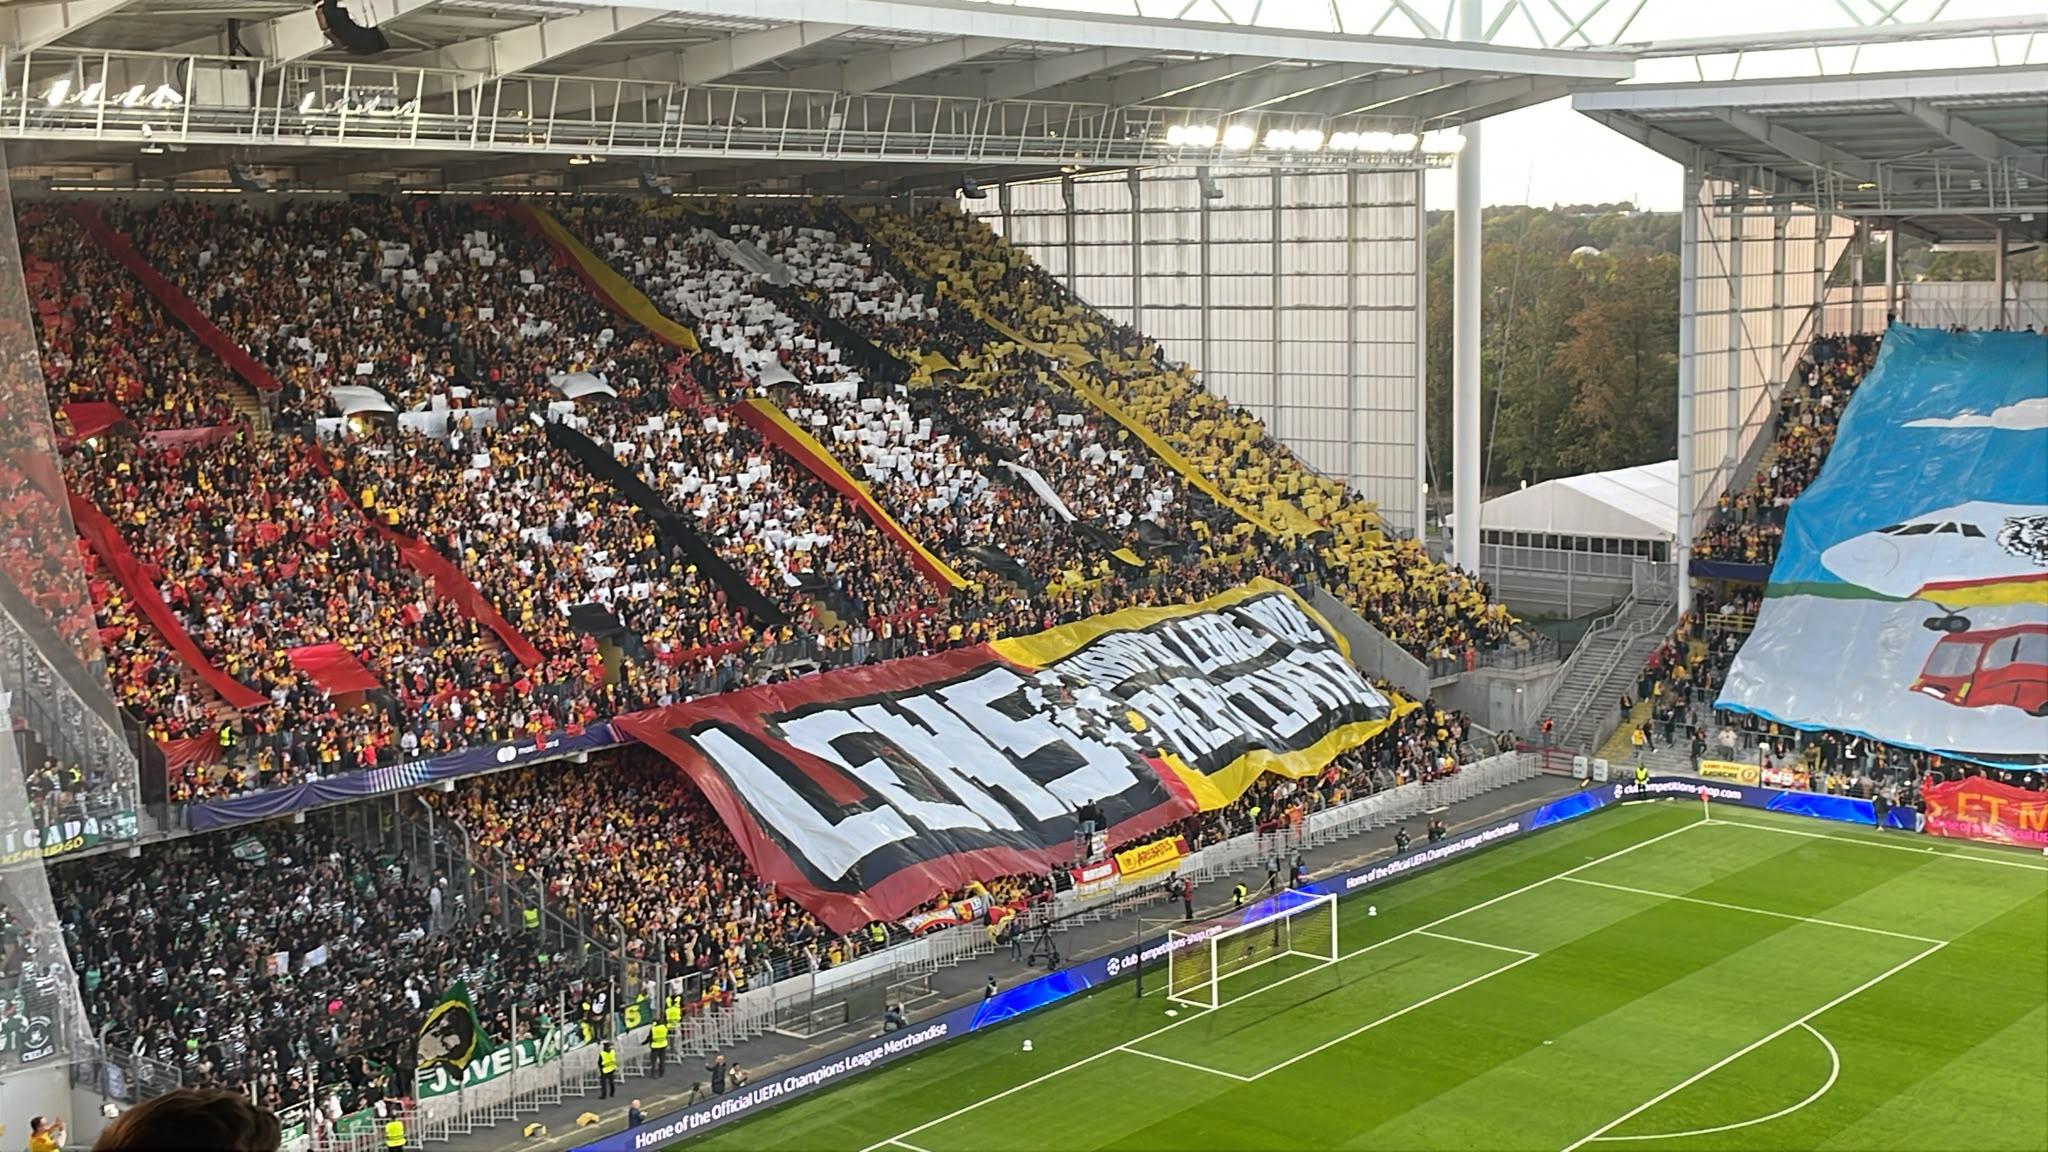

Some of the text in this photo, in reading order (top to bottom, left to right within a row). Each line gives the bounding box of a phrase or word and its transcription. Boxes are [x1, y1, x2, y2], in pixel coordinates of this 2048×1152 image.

[693, 666, 1140, 882] LENS
[1957, 792, 2008, 825] ET
[1346, 822, 1520, 889] Home of the Official UEFA Champions League Merchandise
[635, 1023, 948, 1149] Home of the Official UEFA Champions League Merchandise
